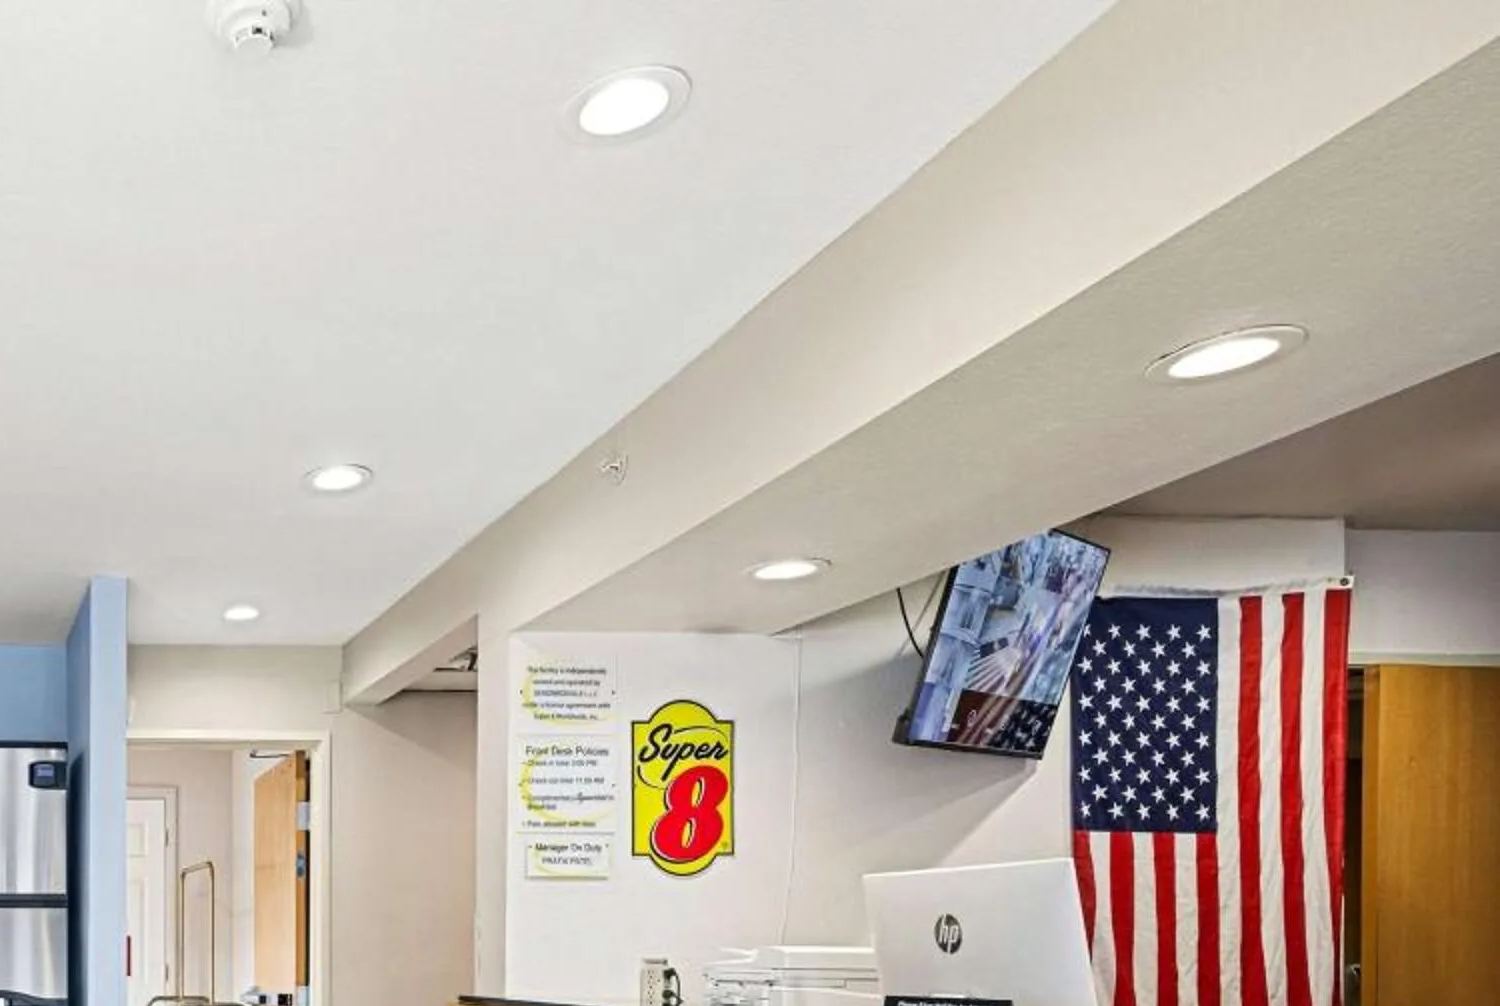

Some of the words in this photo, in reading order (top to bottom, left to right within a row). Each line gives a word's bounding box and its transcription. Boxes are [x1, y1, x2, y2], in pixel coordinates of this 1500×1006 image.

[639, 723, 728, 781] Super
[650, 765, 729, 863] 8
[938, 913, 960, 954] hp
